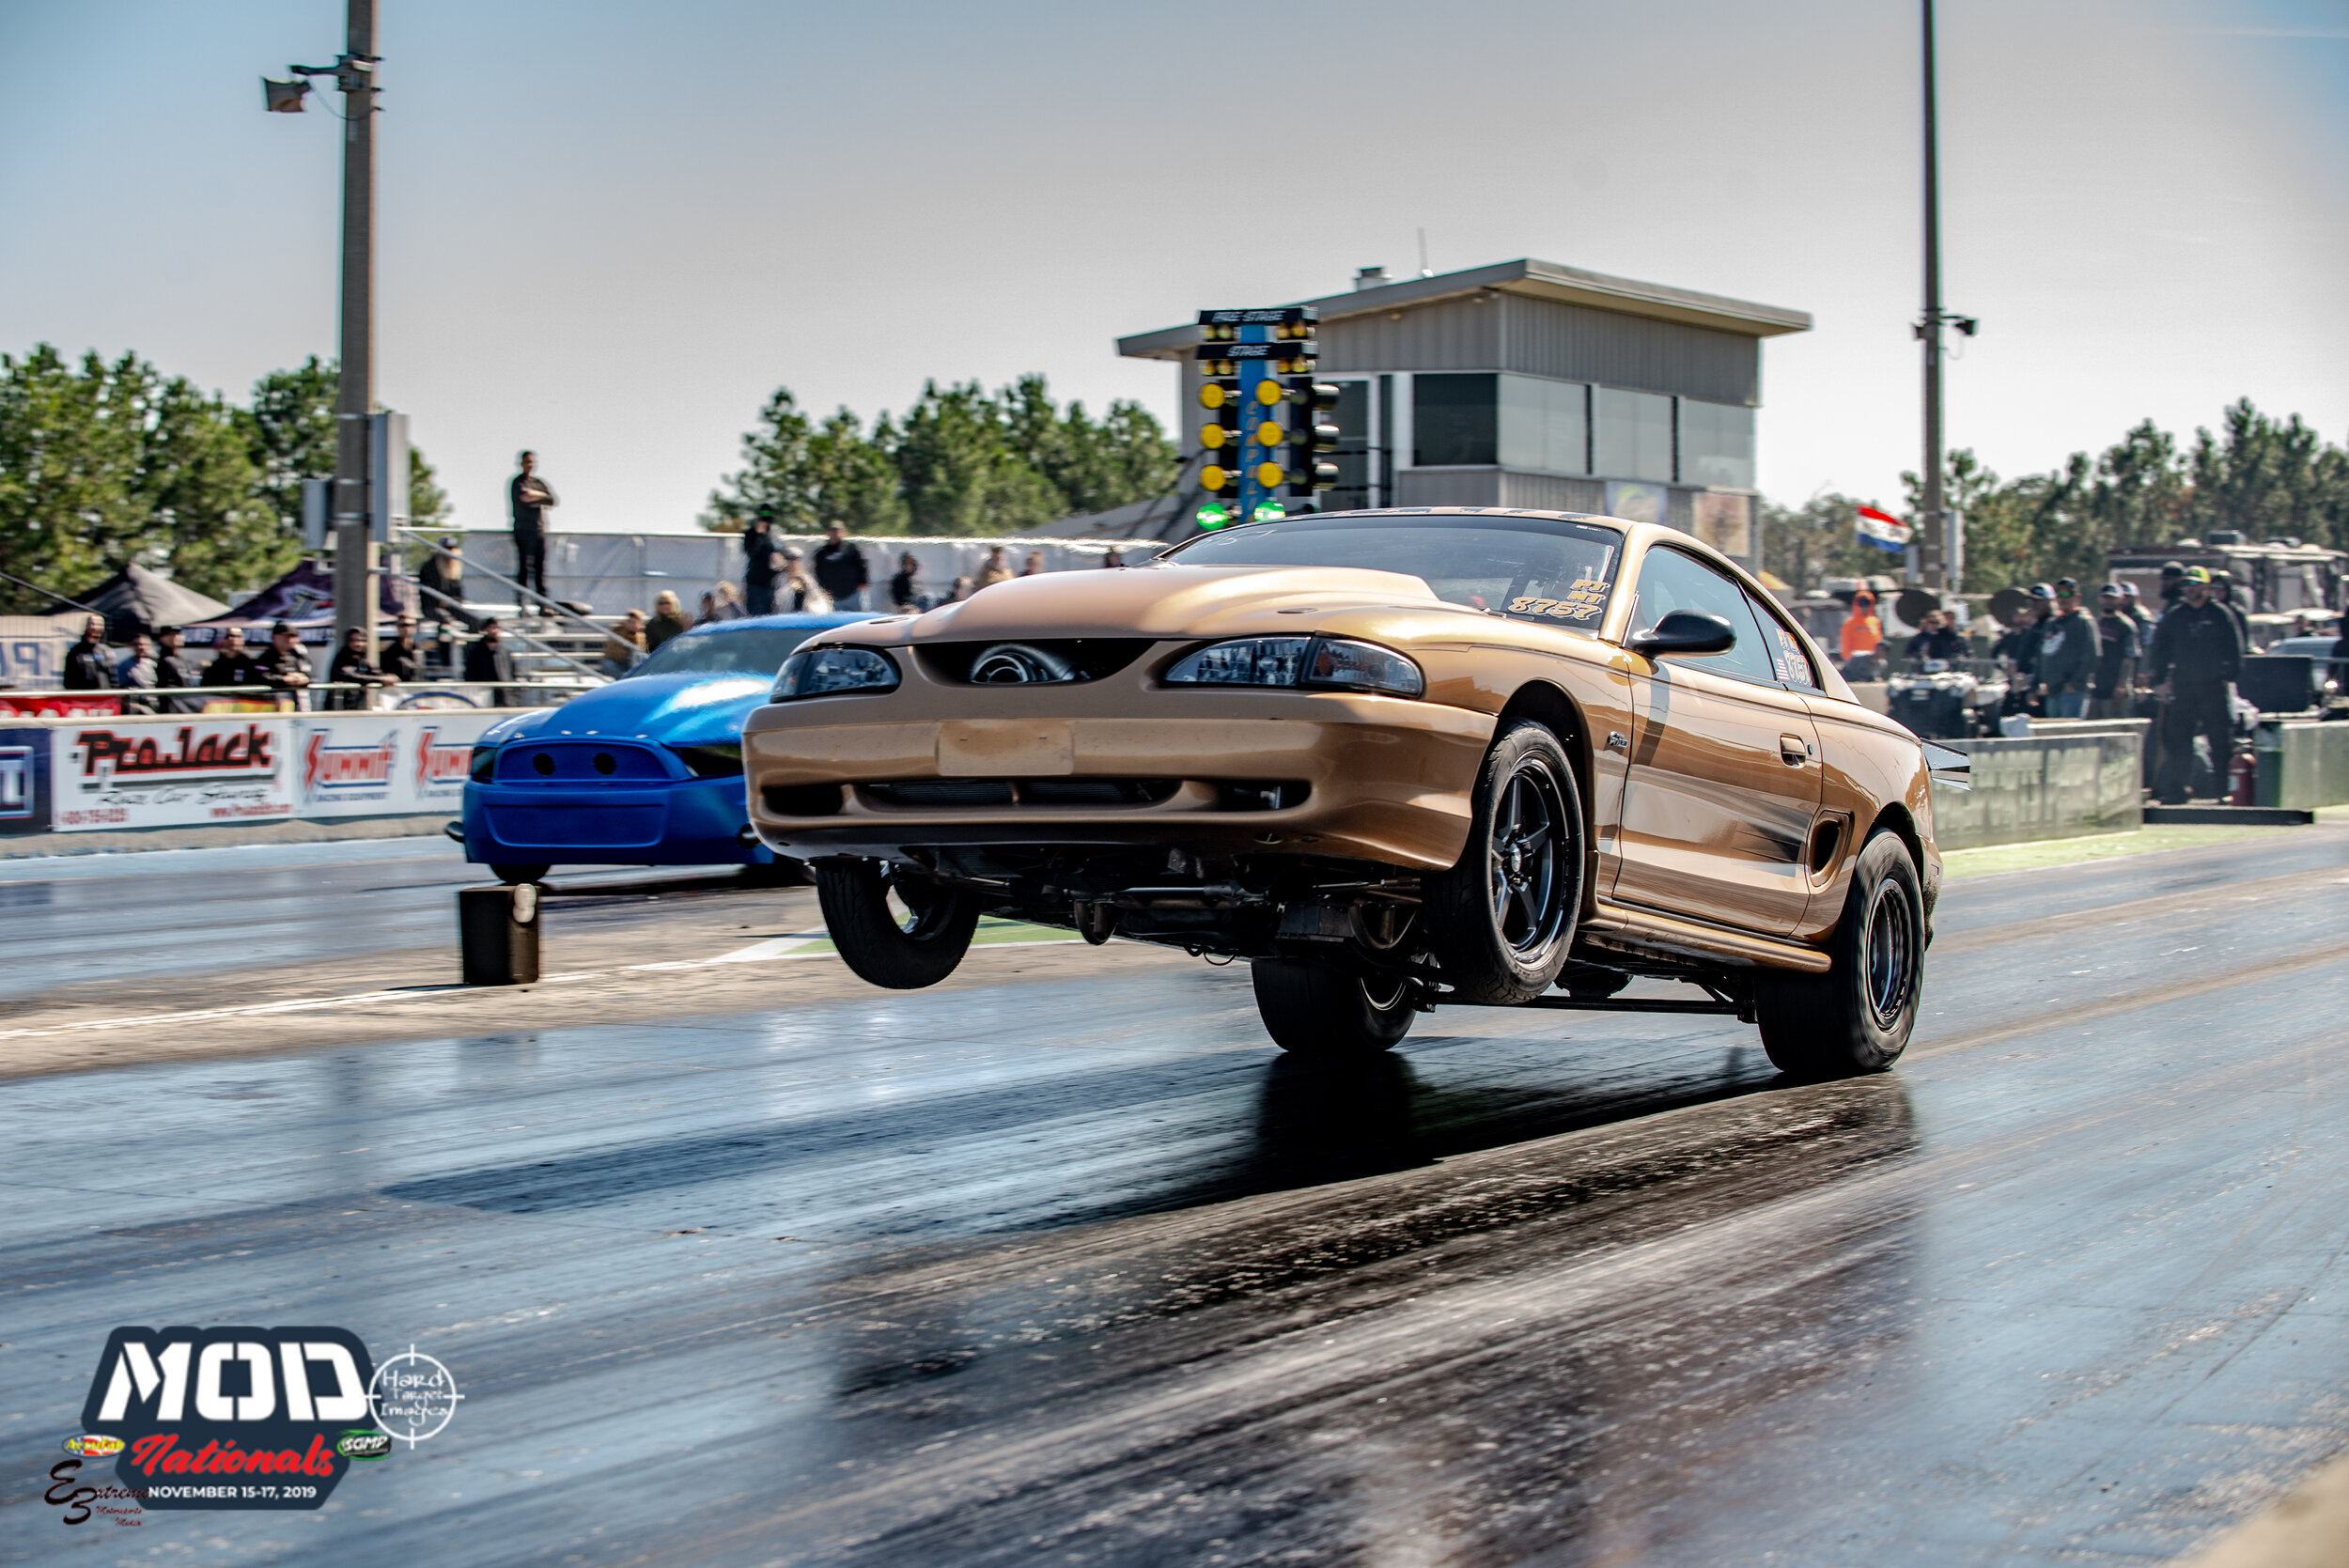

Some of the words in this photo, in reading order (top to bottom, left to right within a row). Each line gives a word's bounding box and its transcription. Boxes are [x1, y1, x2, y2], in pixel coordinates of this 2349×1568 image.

[1225, 344, 1272, 357] STAGE
[1569, 579, 1611, 593] PT
[1507, 596, 1603, 621] 8757
